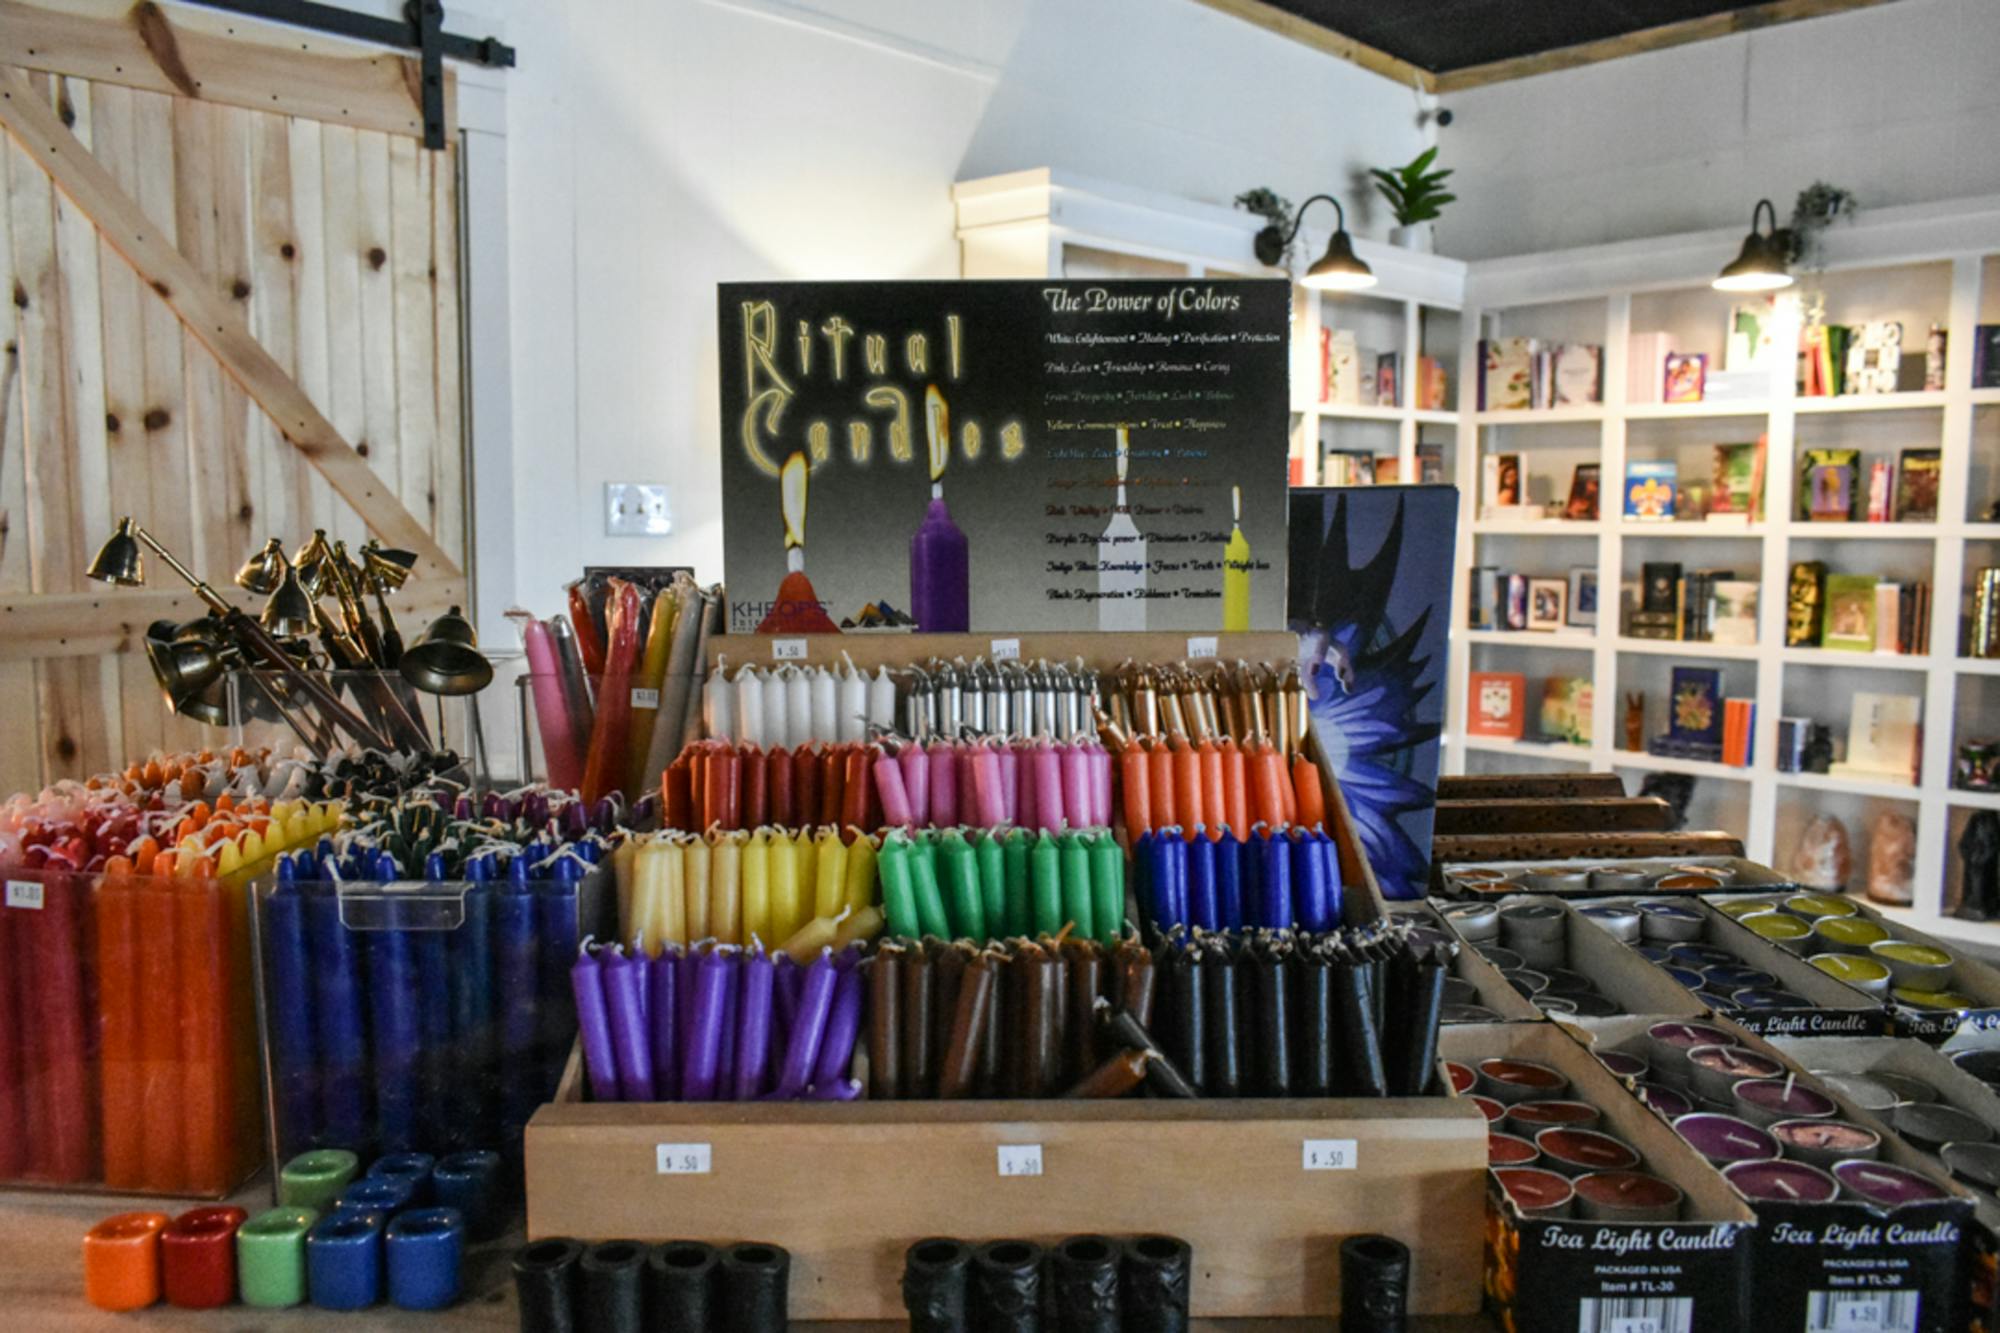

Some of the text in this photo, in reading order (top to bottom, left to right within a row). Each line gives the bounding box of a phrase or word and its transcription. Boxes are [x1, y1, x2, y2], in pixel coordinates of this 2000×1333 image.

[1043, 286, 1241, 320] The Power of Colors
[741, 300, 961, 399] Ritual
[1100, 360, 1147, 376] Friendship
[741, 385, 1026, 478] Candles
[1098, 560, 1144, 574] Knowledge
[1152, 560, 1180, 575] Focus
[1765, 1014, 1807, 1035] Light
[1810, 1013, 1868, 1031] Candle
[1541, 1225, 1736, 1256] Tea Light Candle
[1771, 1220, 1960, 1251] Tea Light Candle
[1594, 1265, 1682, 1274] PACKAGED IN USA
[1823, 1259, 1875, 1268] PACKAGED
[1601, 1281, 1628, 1291] Item
[1828, 1274, 1855, 1285] Item
